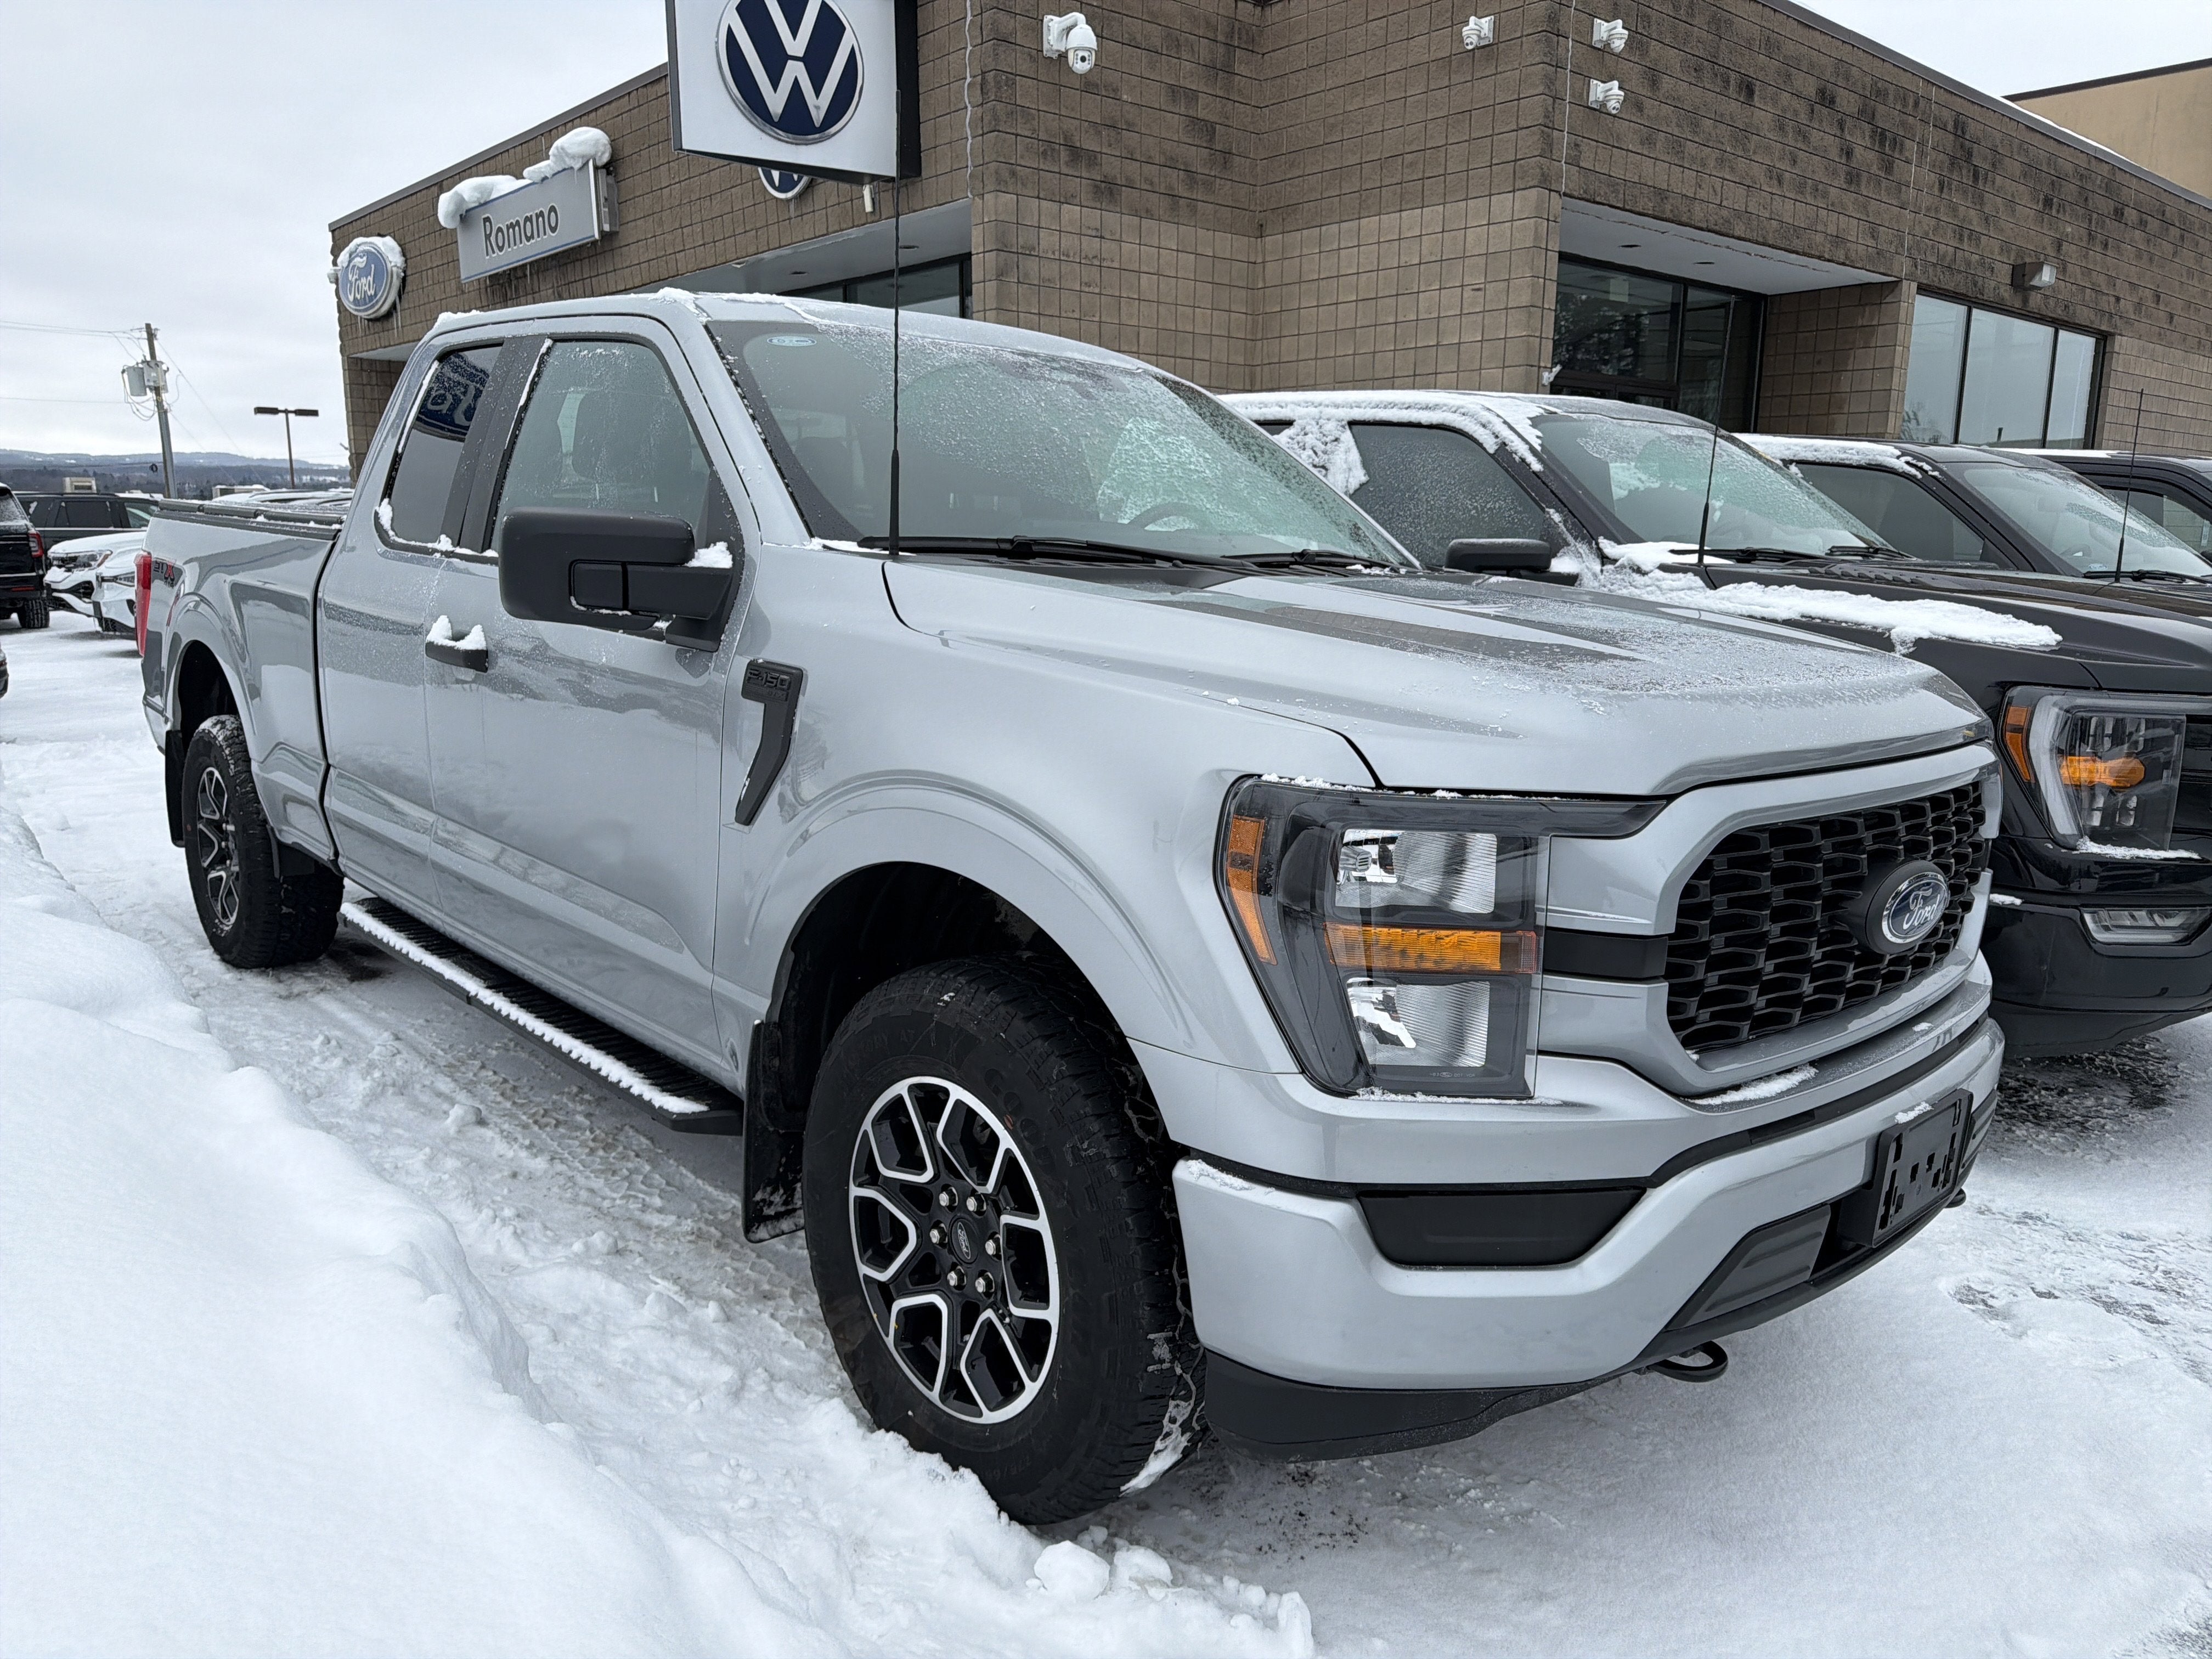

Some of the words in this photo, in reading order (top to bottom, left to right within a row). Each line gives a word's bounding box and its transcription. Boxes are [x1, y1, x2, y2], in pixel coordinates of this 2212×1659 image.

[482, 204, 560, 258] Romano
[347, 253, 376, 302] Ford
[746, 668, 791, 691] F-150
[1903, 884, 1940, 930] Ford
[958, 1229, 969, 1253] Ford
